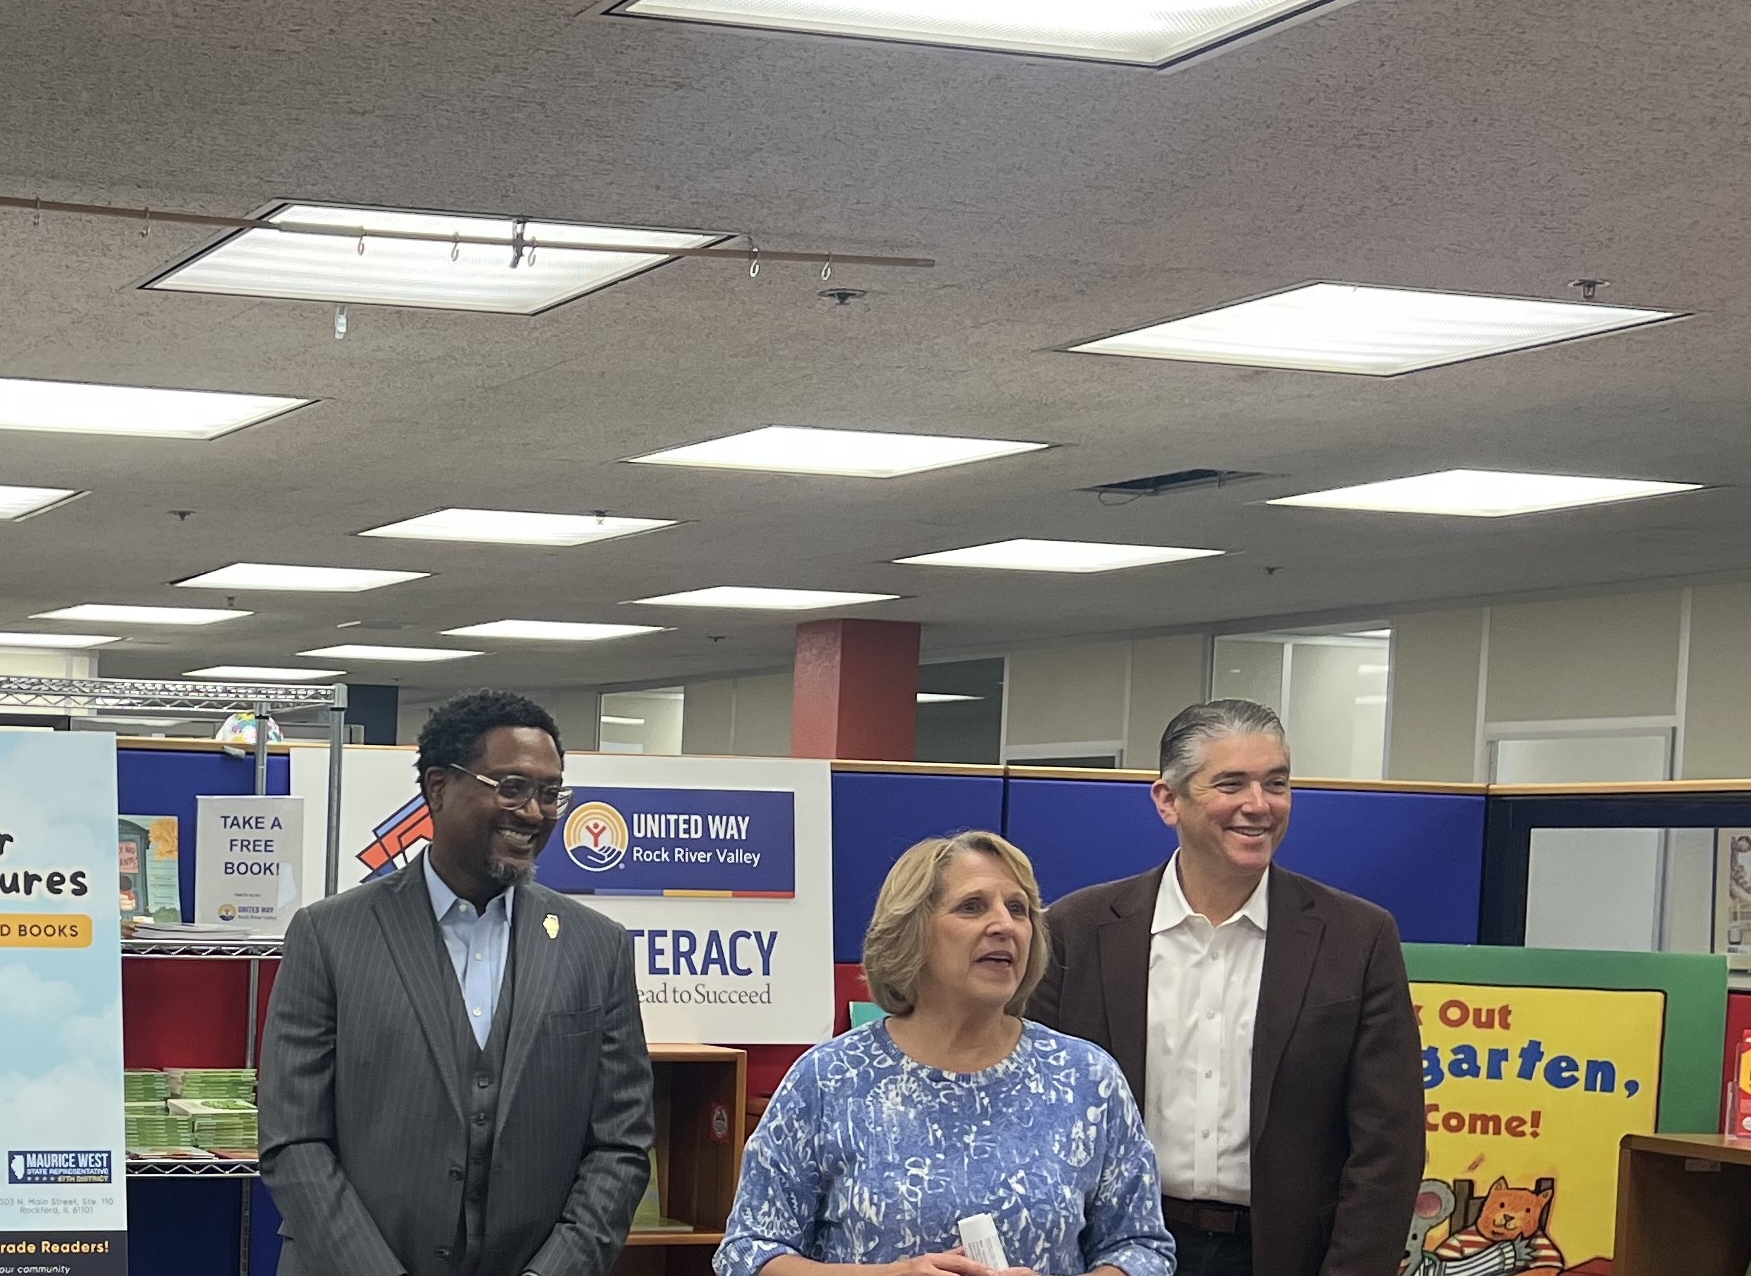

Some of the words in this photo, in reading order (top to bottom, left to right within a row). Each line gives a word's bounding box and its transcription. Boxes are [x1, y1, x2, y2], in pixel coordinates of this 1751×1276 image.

[220, 815, 266, 830] TAKE
[270, 816, 283, 830] A
[632, 813, 703, 839] UNITED
[707, 815, 750, 840] WAY
[229, 838, 275, 853] FREE
[632, 847, 670, 863] Rock
[674, 847, 713, 864] River
[716, 848, 761, 867] Valley
[224, 861, 280, 876] BOOK!
[17, 923, 80, 939] BOOKS
[627, 929, 779, 977] TERACY
[673, 986, 692, 1004] to
[694, 983, 772, 1005] Succeed
[1439, 1000, 1512, 1031] Out
[1420, 1041, 1640, 1098] garten,
[26, 1153, 76, 1168] MAURICE
[78, 1153, 109, 1168] WEST
[41, 1240, 110, 1254] Readers!
